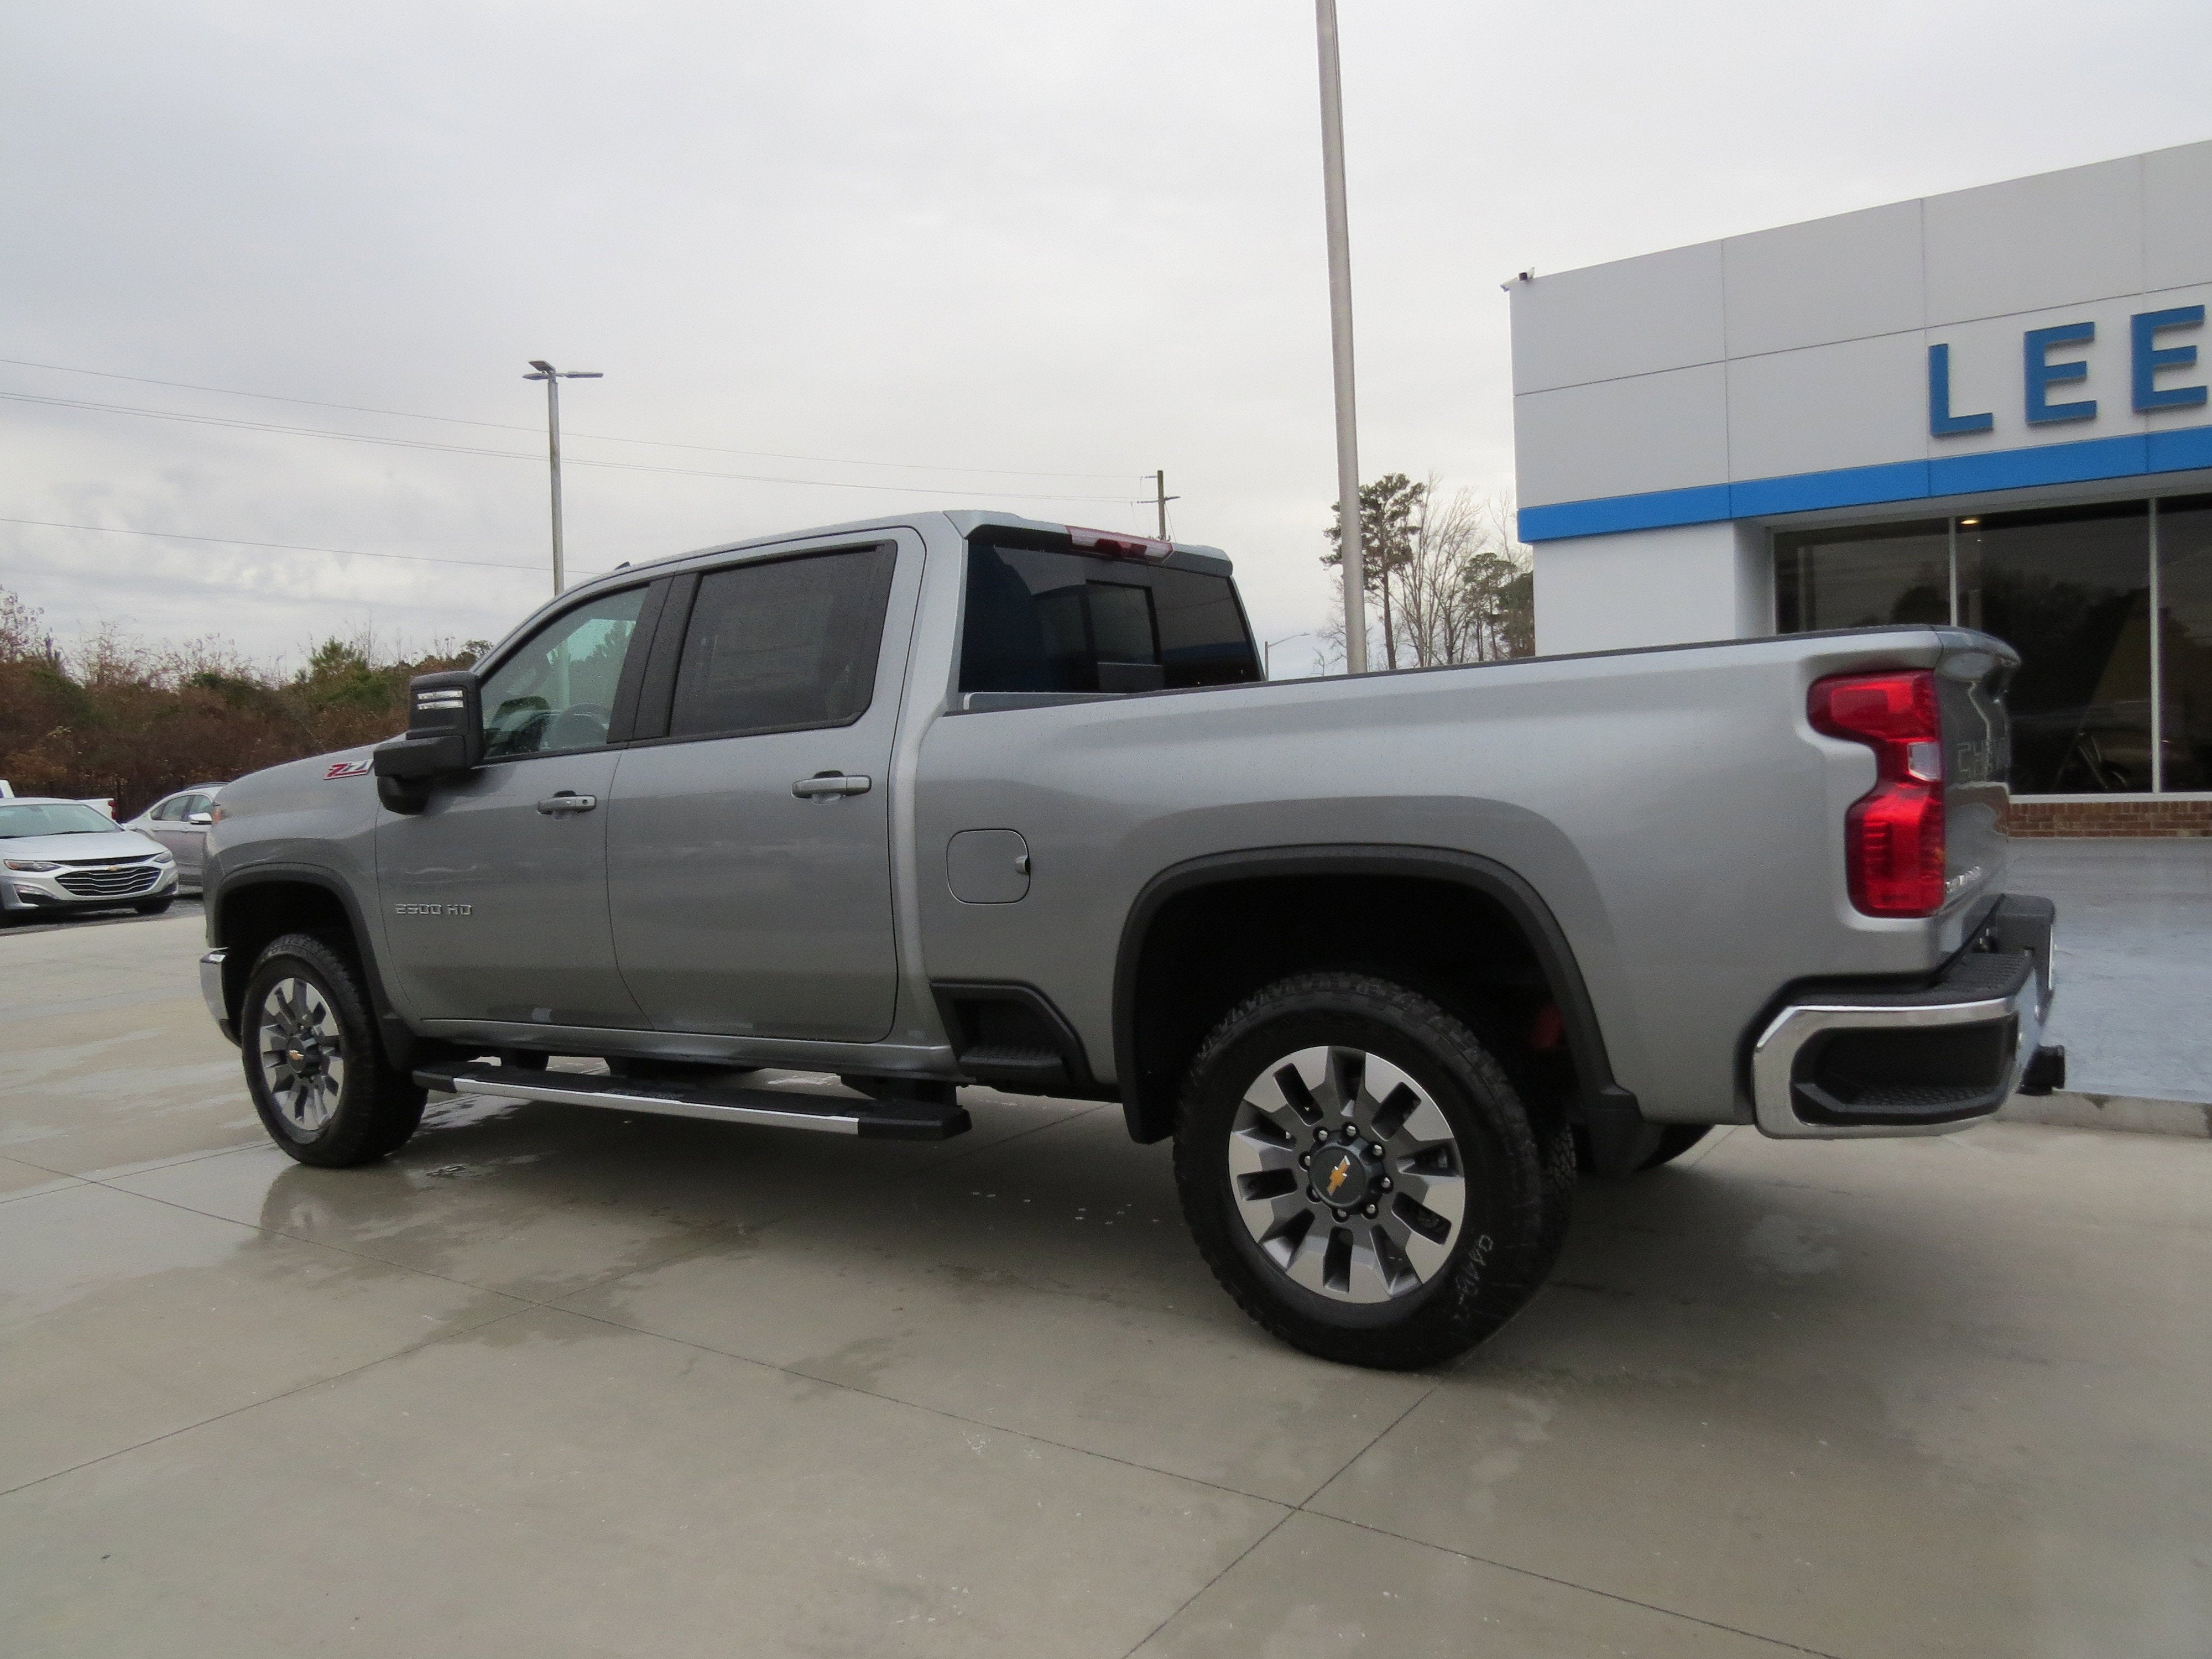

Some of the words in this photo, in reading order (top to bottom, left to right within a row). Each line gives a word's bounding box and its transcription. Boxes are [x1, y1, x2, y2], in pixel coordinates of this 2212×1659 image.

[1928, 305, 2208, 437] LEE
[396, 904, 442, 915] 2500
[446, 904, 472, 915] HD
